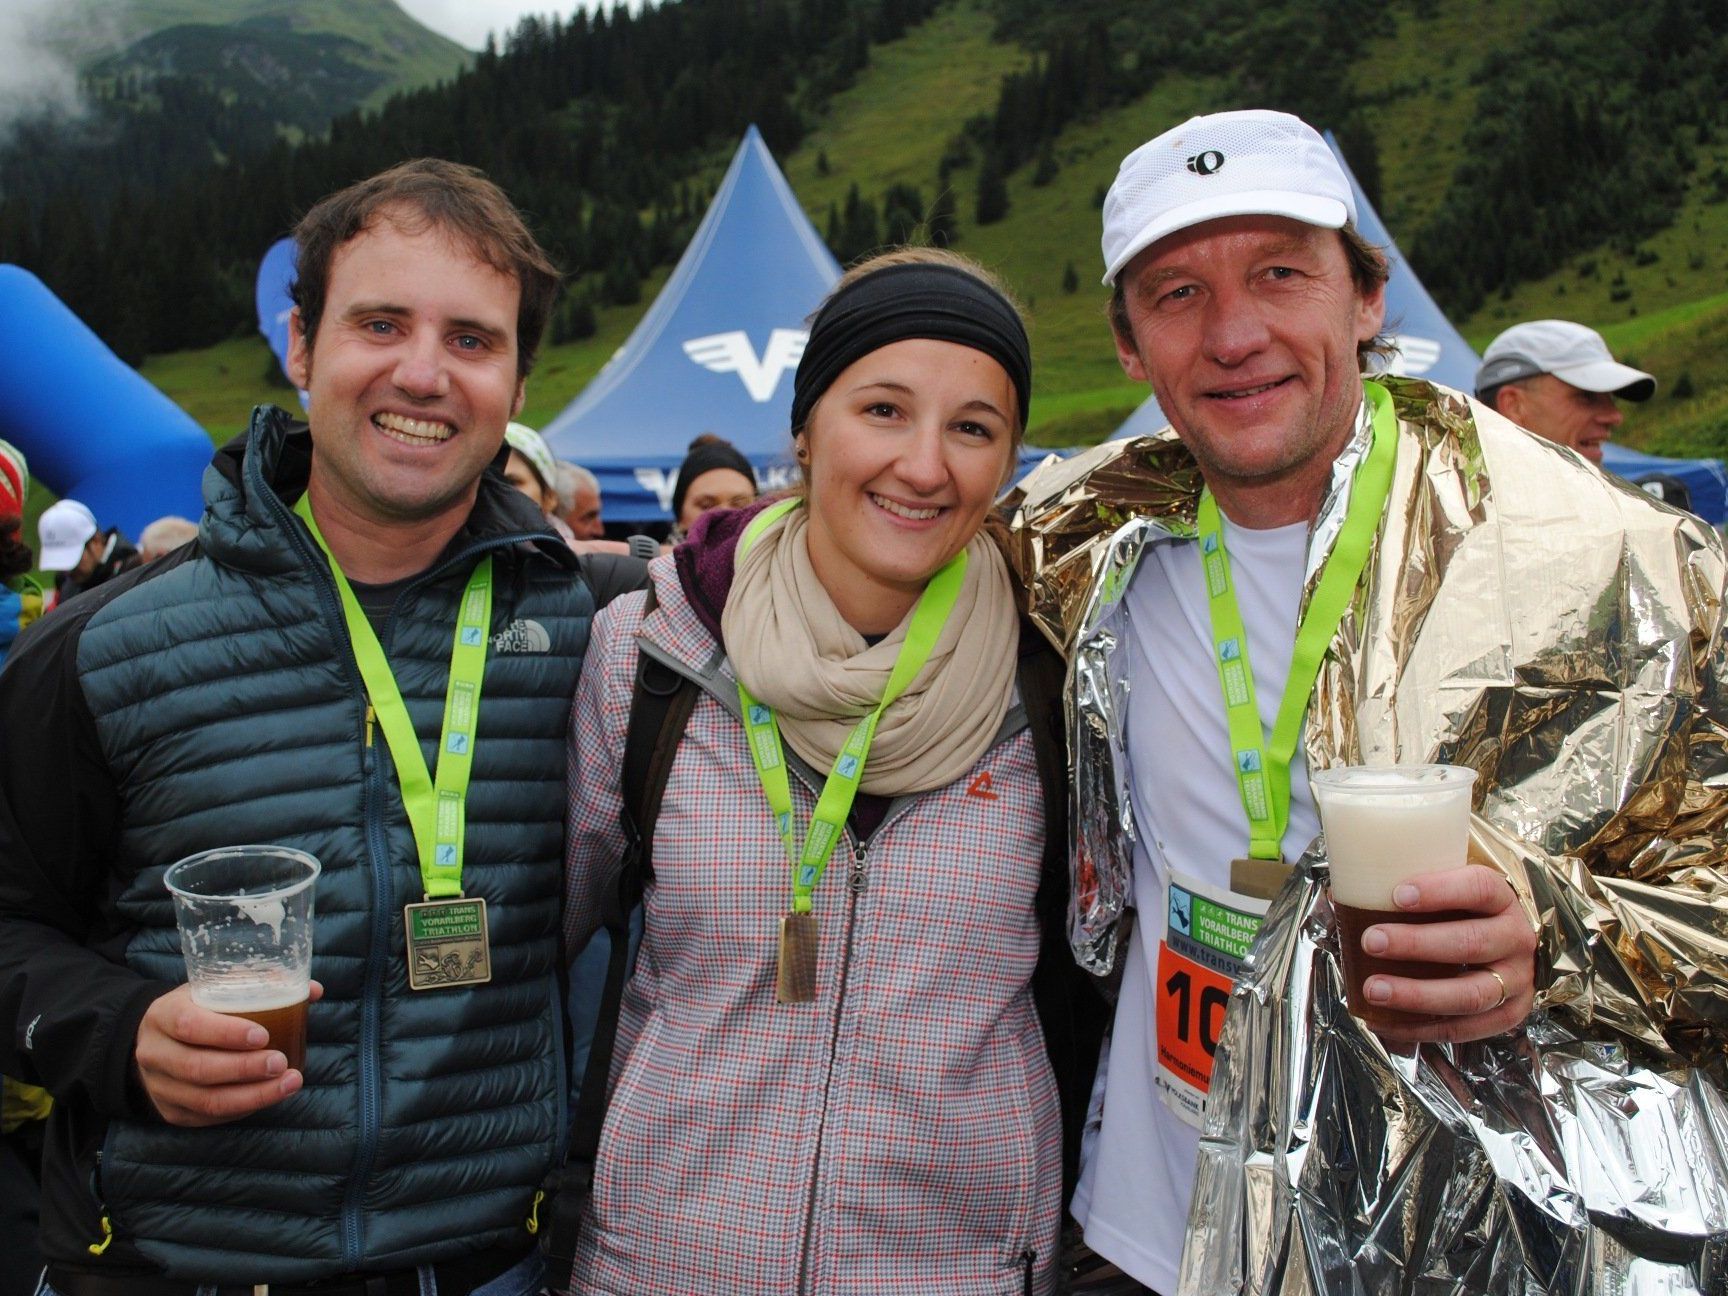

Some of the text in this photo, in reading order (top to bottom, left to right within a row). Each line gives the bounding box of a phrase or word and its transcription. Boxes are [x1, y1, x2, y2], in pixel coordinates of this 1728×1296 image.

[496, 640, 528, 653] FACE
[450, 906, 476, 915] TRANS
[422, 914, 477, 927] VORARLBERG
[1226, 911, 1258, 931] TRANS
[423, 924, 478, 936] TRIATHLON
[1199, 929, 1248, 957] TRIATHLO
[1172, 935, 1240, 975] www.transv
[1161, 1044, 1210, 1086] Harmoniemu
